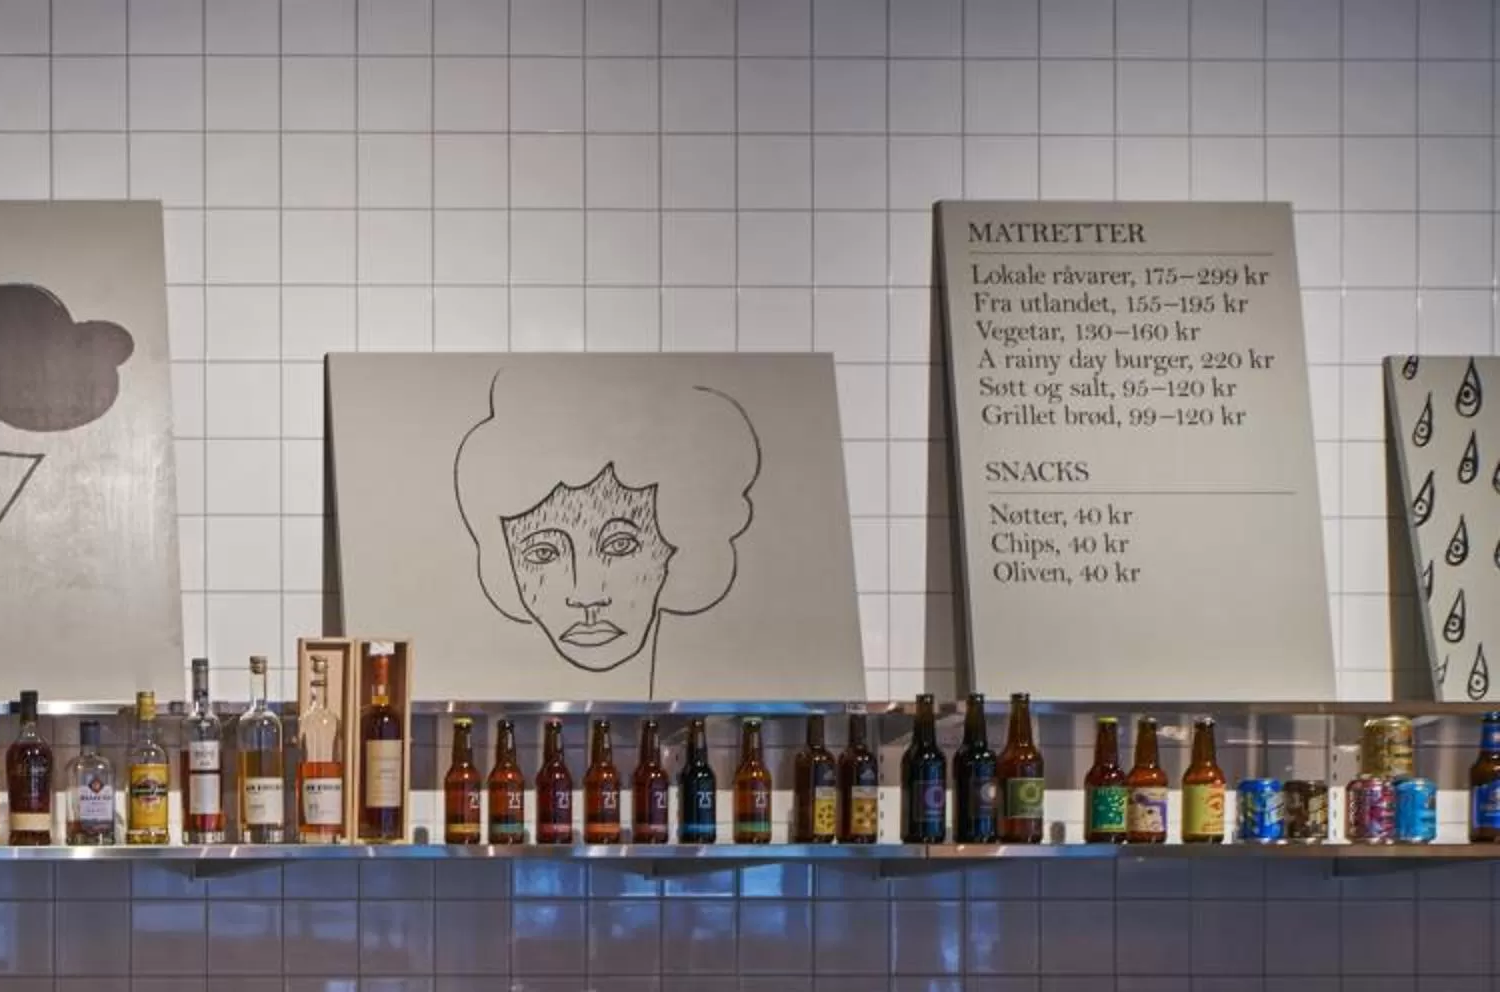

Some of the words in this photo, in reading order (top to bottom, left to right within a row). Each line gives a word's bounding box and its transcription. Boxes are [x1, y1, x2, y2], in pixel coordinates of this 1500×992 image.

[967, 222, 1147, 244] MATRETTER
[972, 263, 1047, 286] Lokale
[1052, 265, 1136, 289] råvarer,
[1244, 263, 1269, 286] kr
[973, 291, 1013, 314] Fra
[1020, 291, 1116, 317] utlandet,
[1222, 291, 1249, 315] kr
[975, 319, 1066, 346] Vegetar,
[1175, 319, 1202, 342] kr
[977, 348, 998, 370] A
[1004, 348, 1061, 376] rainy
[1068, 347, 1108, 376] day
[1114, 348, 1194, 375] burger,
[1200, 351, 1243, 370] 220
[1248, 347, 1276, 370] kr
[979, 376, 1027, 398] Søtt
[1033, 382, 1064, 403] og
[1069, 376, 1117, 401] salt,
[1211, 376, 1238, 399] kr
[980, 404, 1057, 427] Grillet
[1063, 403, 1123, 429] brød,
[1220, 403, 1247, 427] kr
[985, 460, 1091, 483] SNACKS
[988, 503, 1068, 529] Nøtter,
[1073, 507, 1103, 526] 40
[1107, 503, 1134, 527] kr
[990, 531, 1061, 561] Chips,
[1067, 535, 1098, 555] 40
[1103, 531, 1131, 555] kr
[992, 559, 1074, 586] Oliven,
[1079, 563, 1109, 583] 40
[1113, 559, 1141, 584] kr
